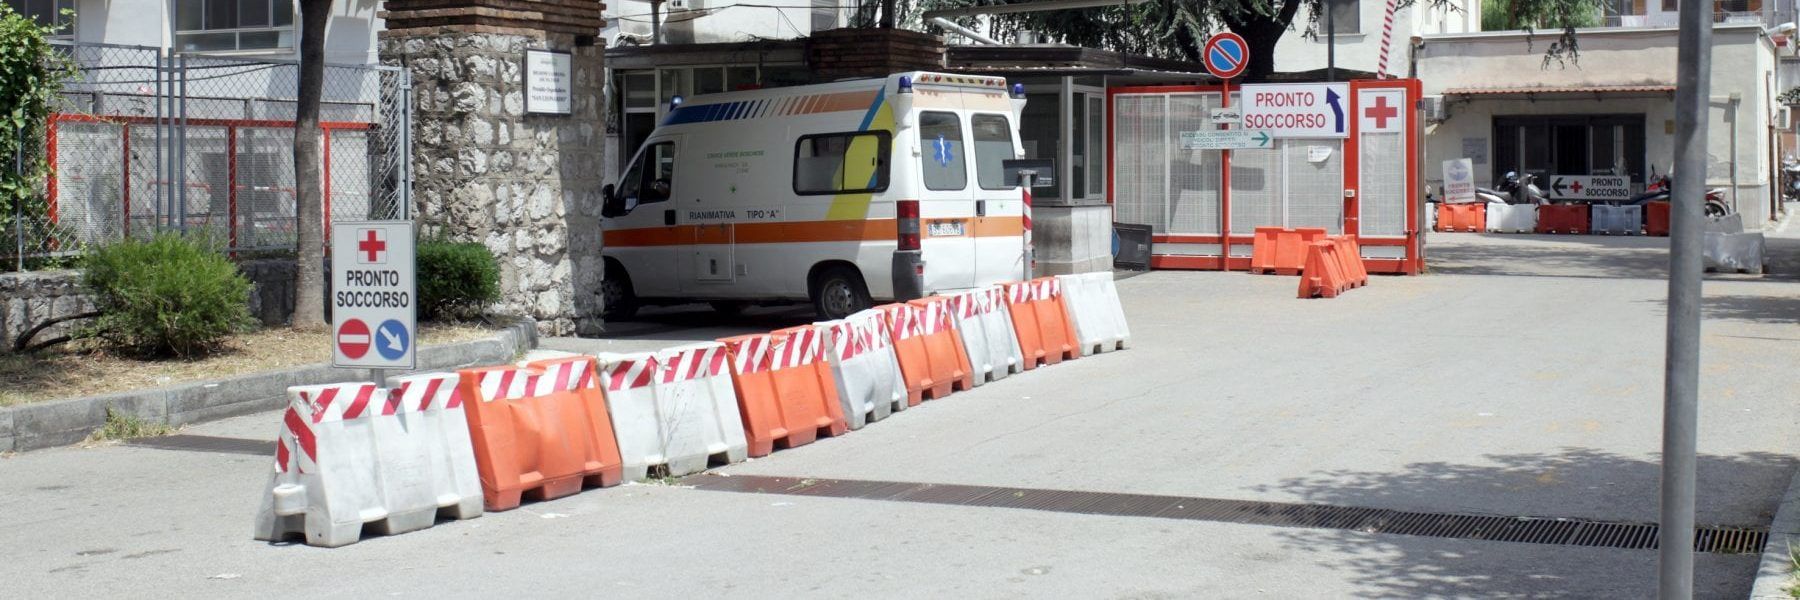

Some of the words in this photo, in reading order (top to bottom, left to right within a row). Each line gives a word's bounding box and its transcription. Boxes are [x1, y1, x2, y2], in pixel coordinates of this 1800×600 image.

[1255, 92, 1315, 107] PRONTO
[1245, 113, 1326, 129] SOCCORSO
[1591, 177, 1623, 188] PRONTO
[1586, 188, 1629, 197] SOCCORSO
[689, 210, 736, 220] RIANIMATIVA
[746, 210, 764, 219] TIPO
[346, 270, 399, 287] PRONTO
[337, 291, 409, 308] SOCCORSO
